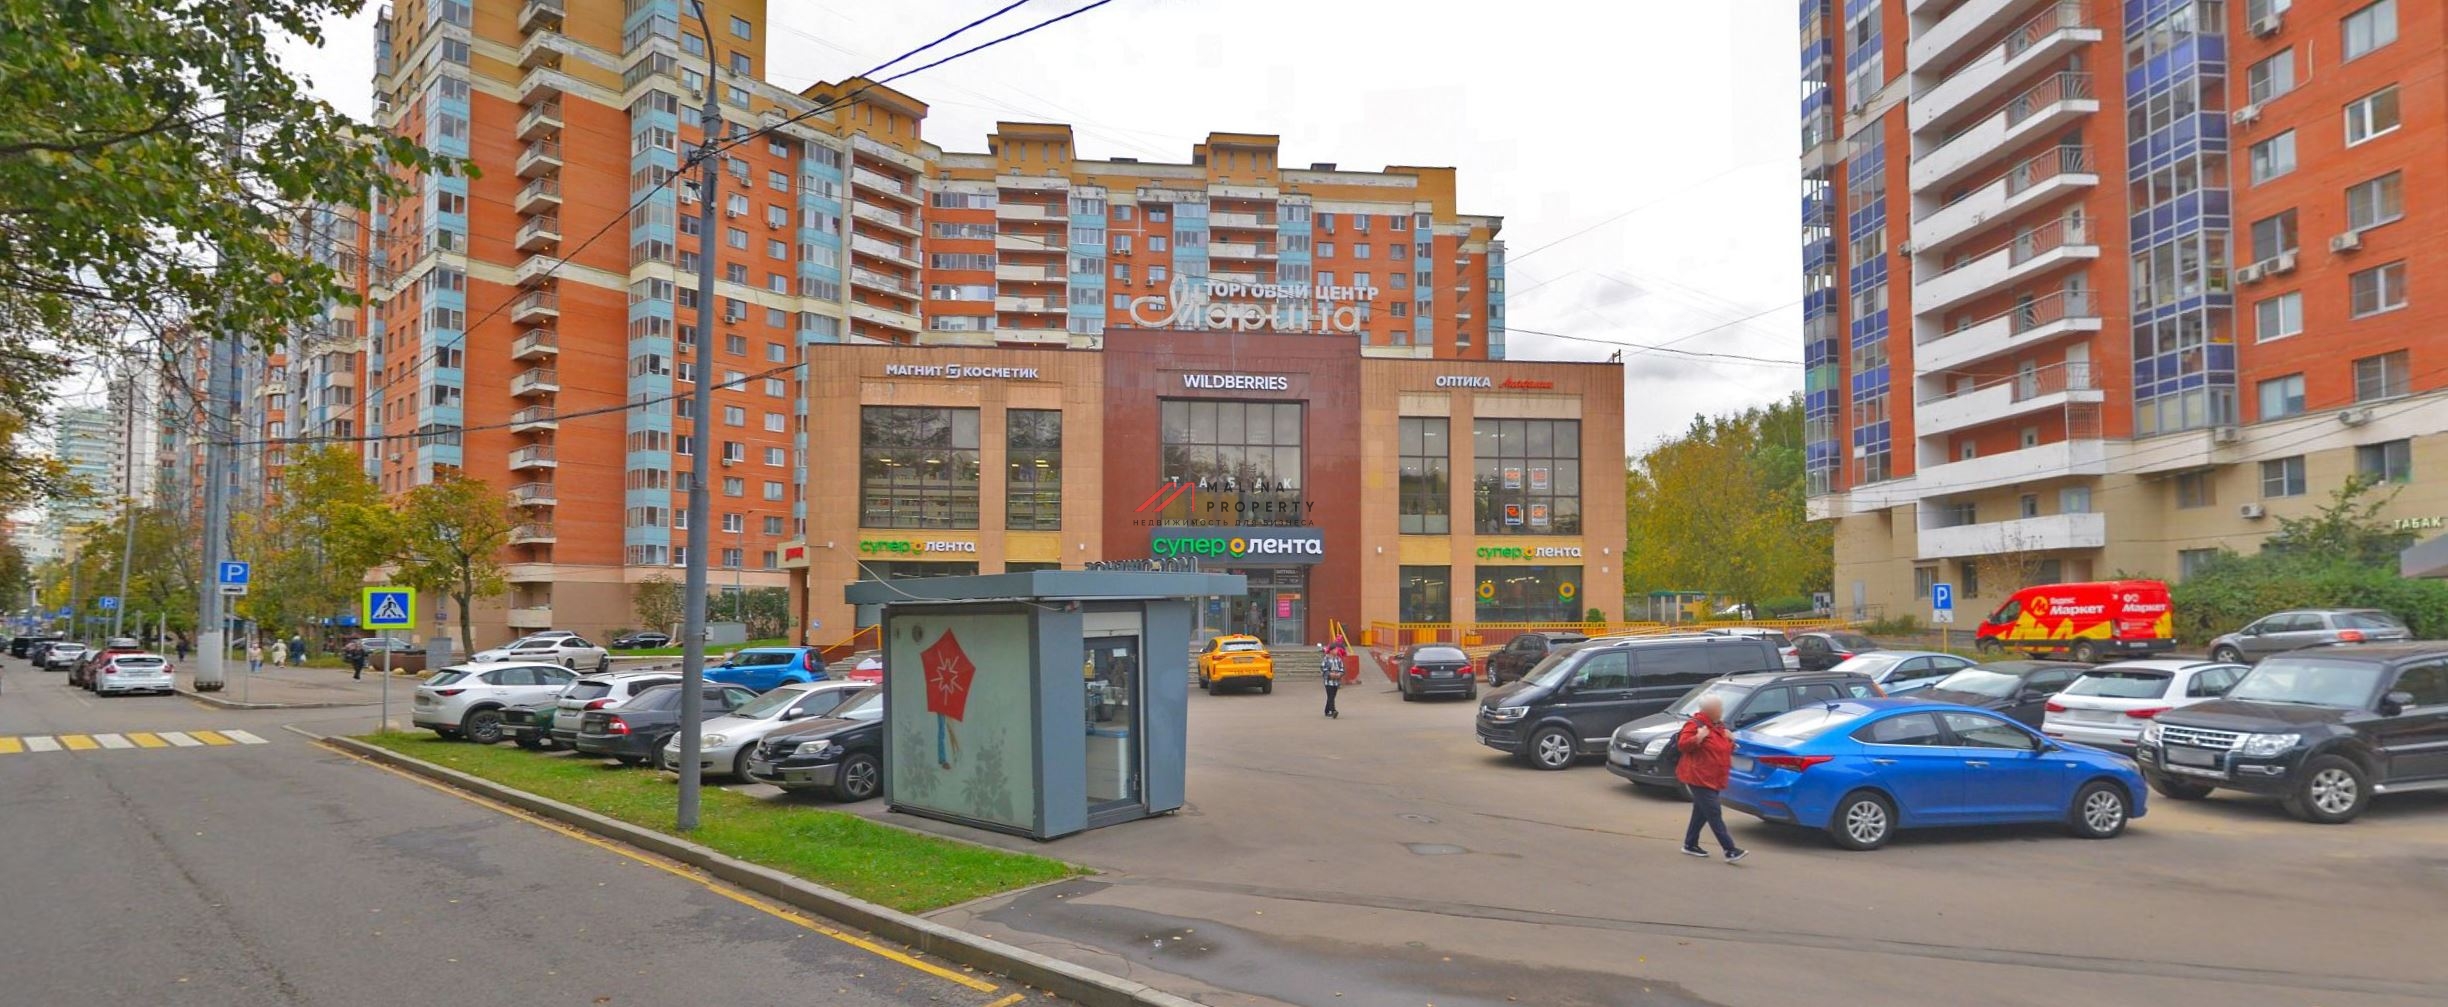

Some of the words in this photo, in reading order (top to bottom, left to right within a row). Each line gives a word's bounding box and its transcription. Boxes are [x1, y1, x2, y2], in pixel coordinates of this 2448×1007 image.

[1205, 281, 1309, 300] ТОРГОВЫЙ
[1315, 285, 1380, 302] ЦЕНТР
[885, 364, 944, 378] МАГНИТ
[963, 366, 1039, 380] КОСМЕТИК
[1183, 373, 1289, 391] WILDBERRIES
[1435, 375, 1493, 388] ОПТИКА
[2394, 516, 2441, 530] ТАБАК
[859, 539, 911, 554] супер
[924, 540, 976, 553] лента
[1152, 536, 1227, 557] супер
[1247, 537, 1323, 555] лента
[1476, 546, 1523, 560] супер
[1535, 546, 1582, 557] лента
[227, 564, 244, 582] P
[1937, 586, 1948, 608] P
[2049, 604, 2105, 616] Маркет
